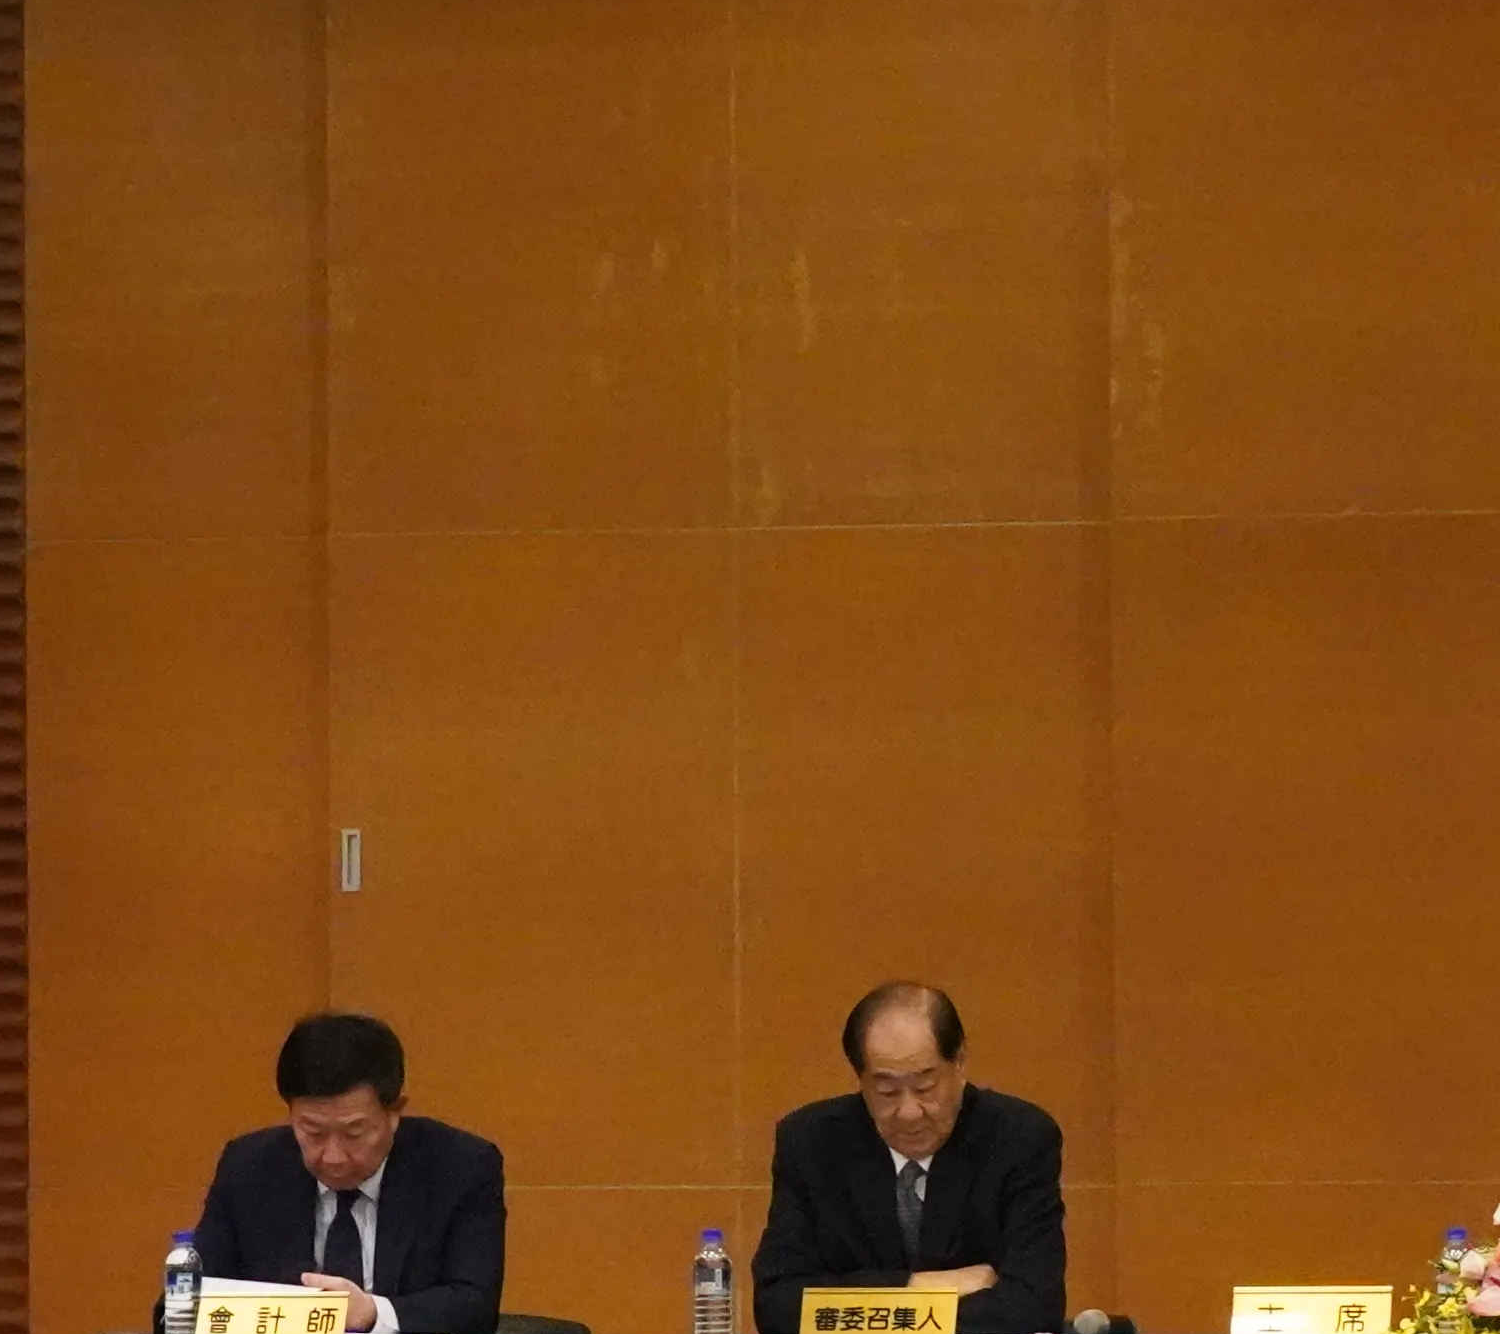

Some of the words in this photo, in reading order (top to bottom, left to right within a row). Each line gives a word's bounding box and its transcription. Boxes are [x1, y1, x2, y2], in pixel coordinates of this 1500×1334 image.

[207, 1305, 340, 1334] 會計師
[814, 1305, 942, 1332] 審委召集人
